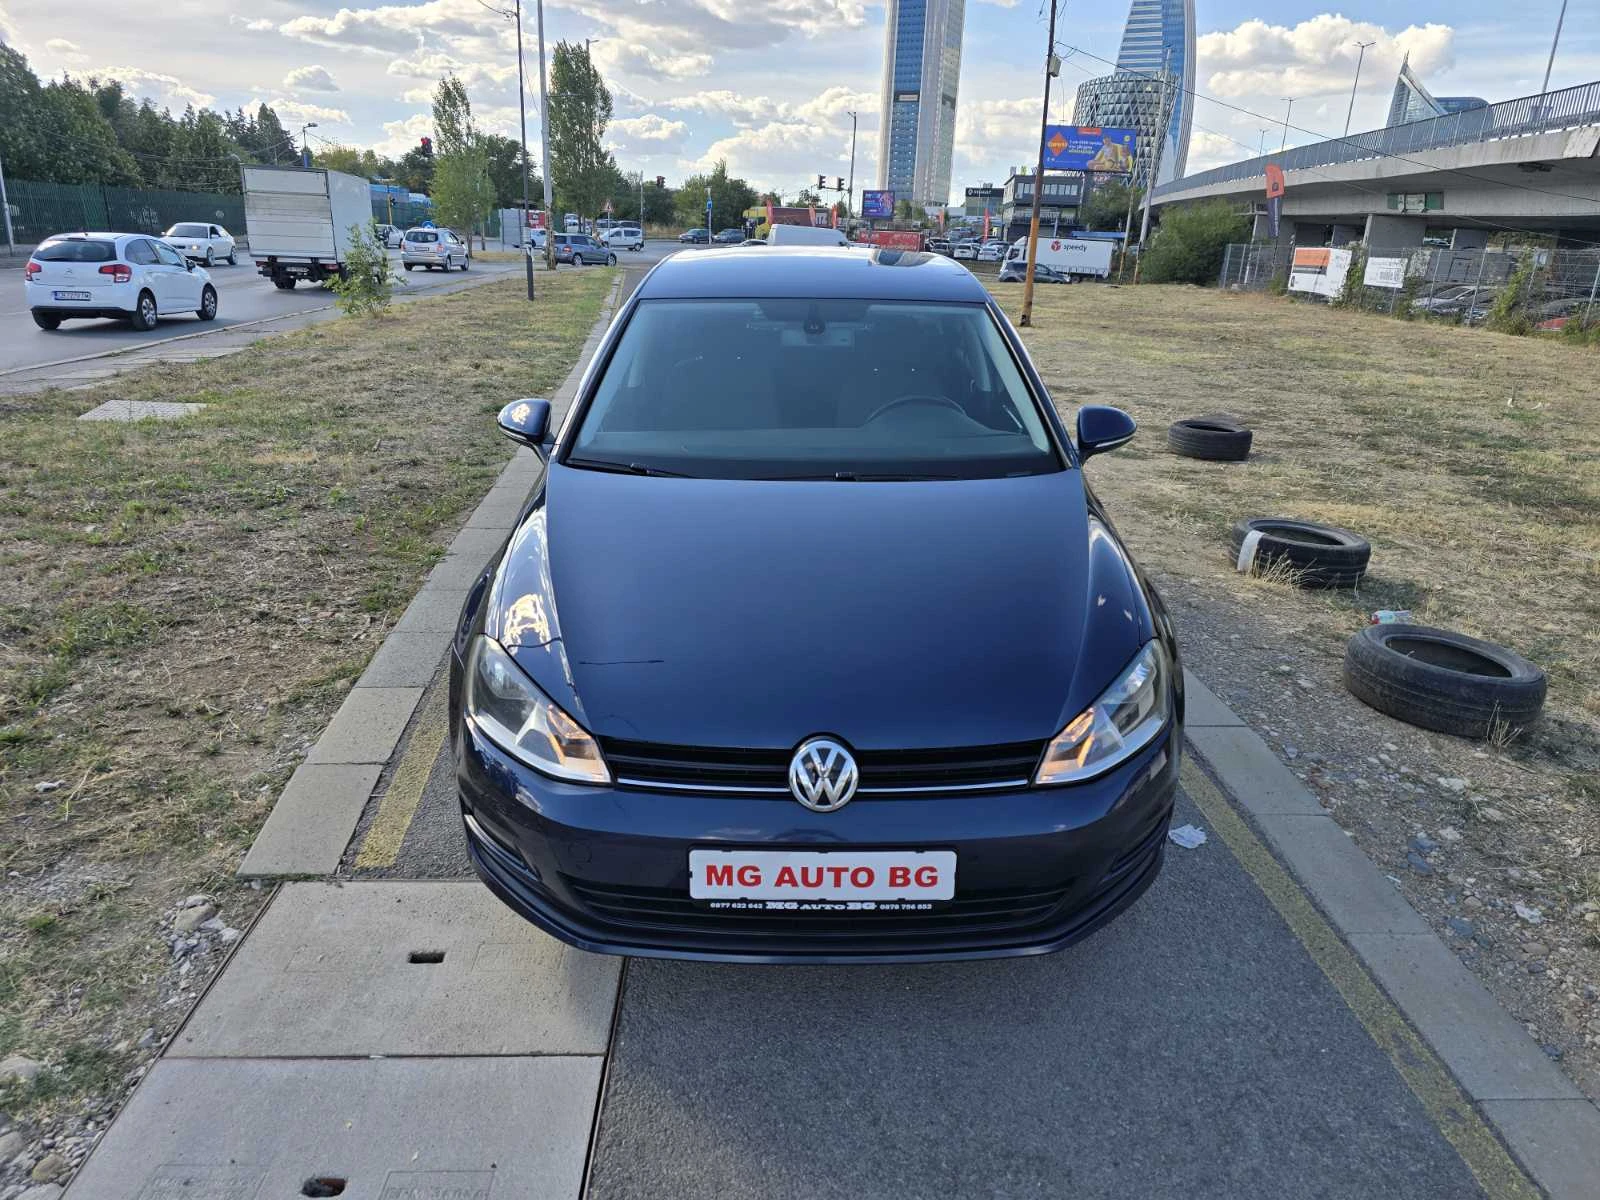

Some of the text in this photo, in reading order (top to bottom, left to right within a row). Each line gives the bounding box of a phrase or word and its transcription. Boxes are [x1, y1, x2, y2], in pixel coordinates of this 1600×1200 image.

[1064, 243, 1087, 253] speedy
[706, 865, 938, 888] MG AUTO BG
